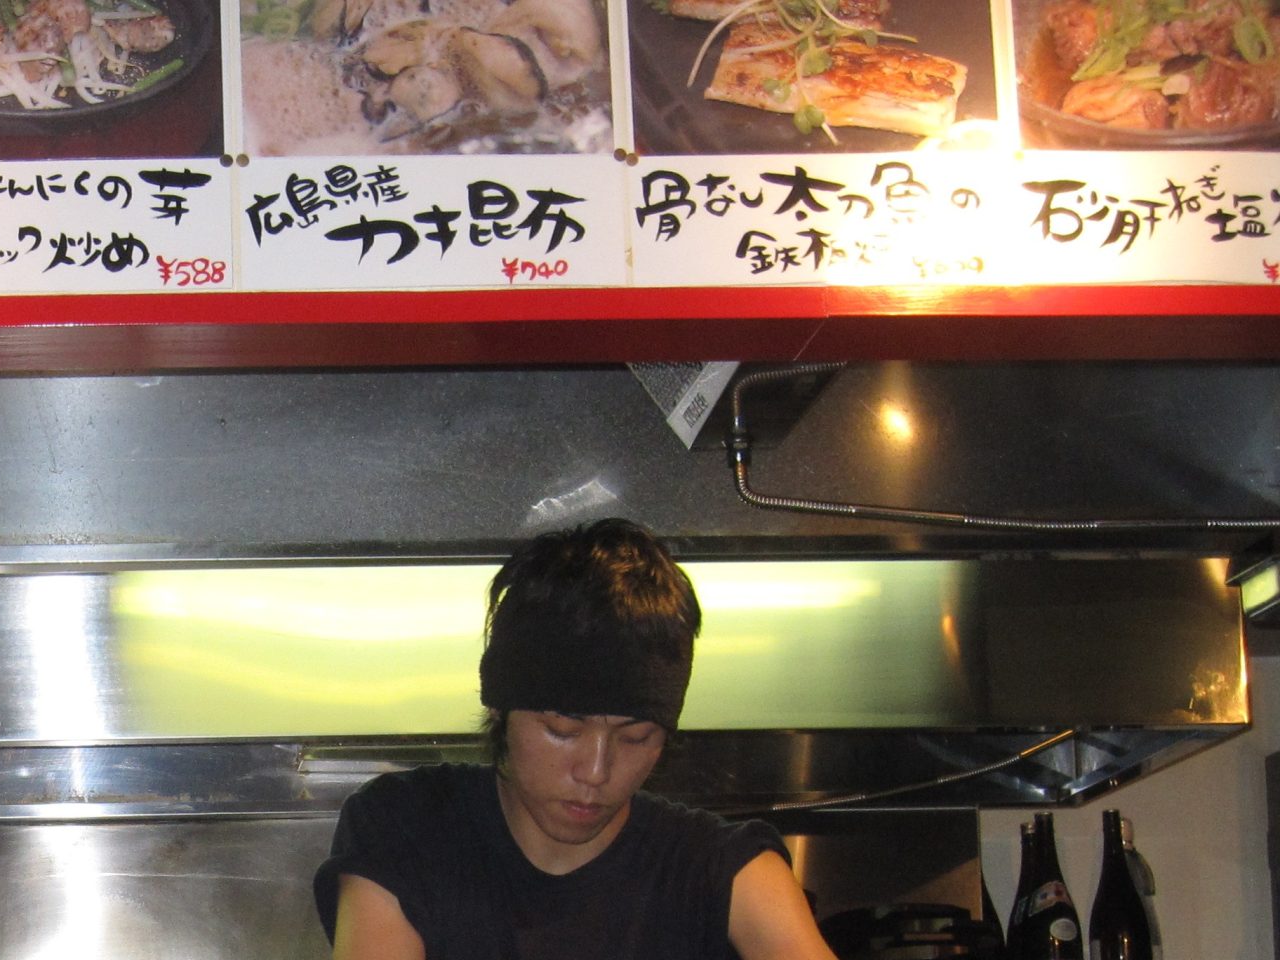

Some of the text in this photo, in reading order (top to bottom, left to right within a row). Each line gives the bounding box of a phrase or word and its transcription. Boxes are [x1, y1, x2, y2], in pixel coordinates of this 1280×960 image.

[245, 164, 409, 248] 広島県産
[324, 180, 589, 266] カキ昆布
[156, 255, 226, 286] ¥588
[501, 257, 569, 284] ¥740
